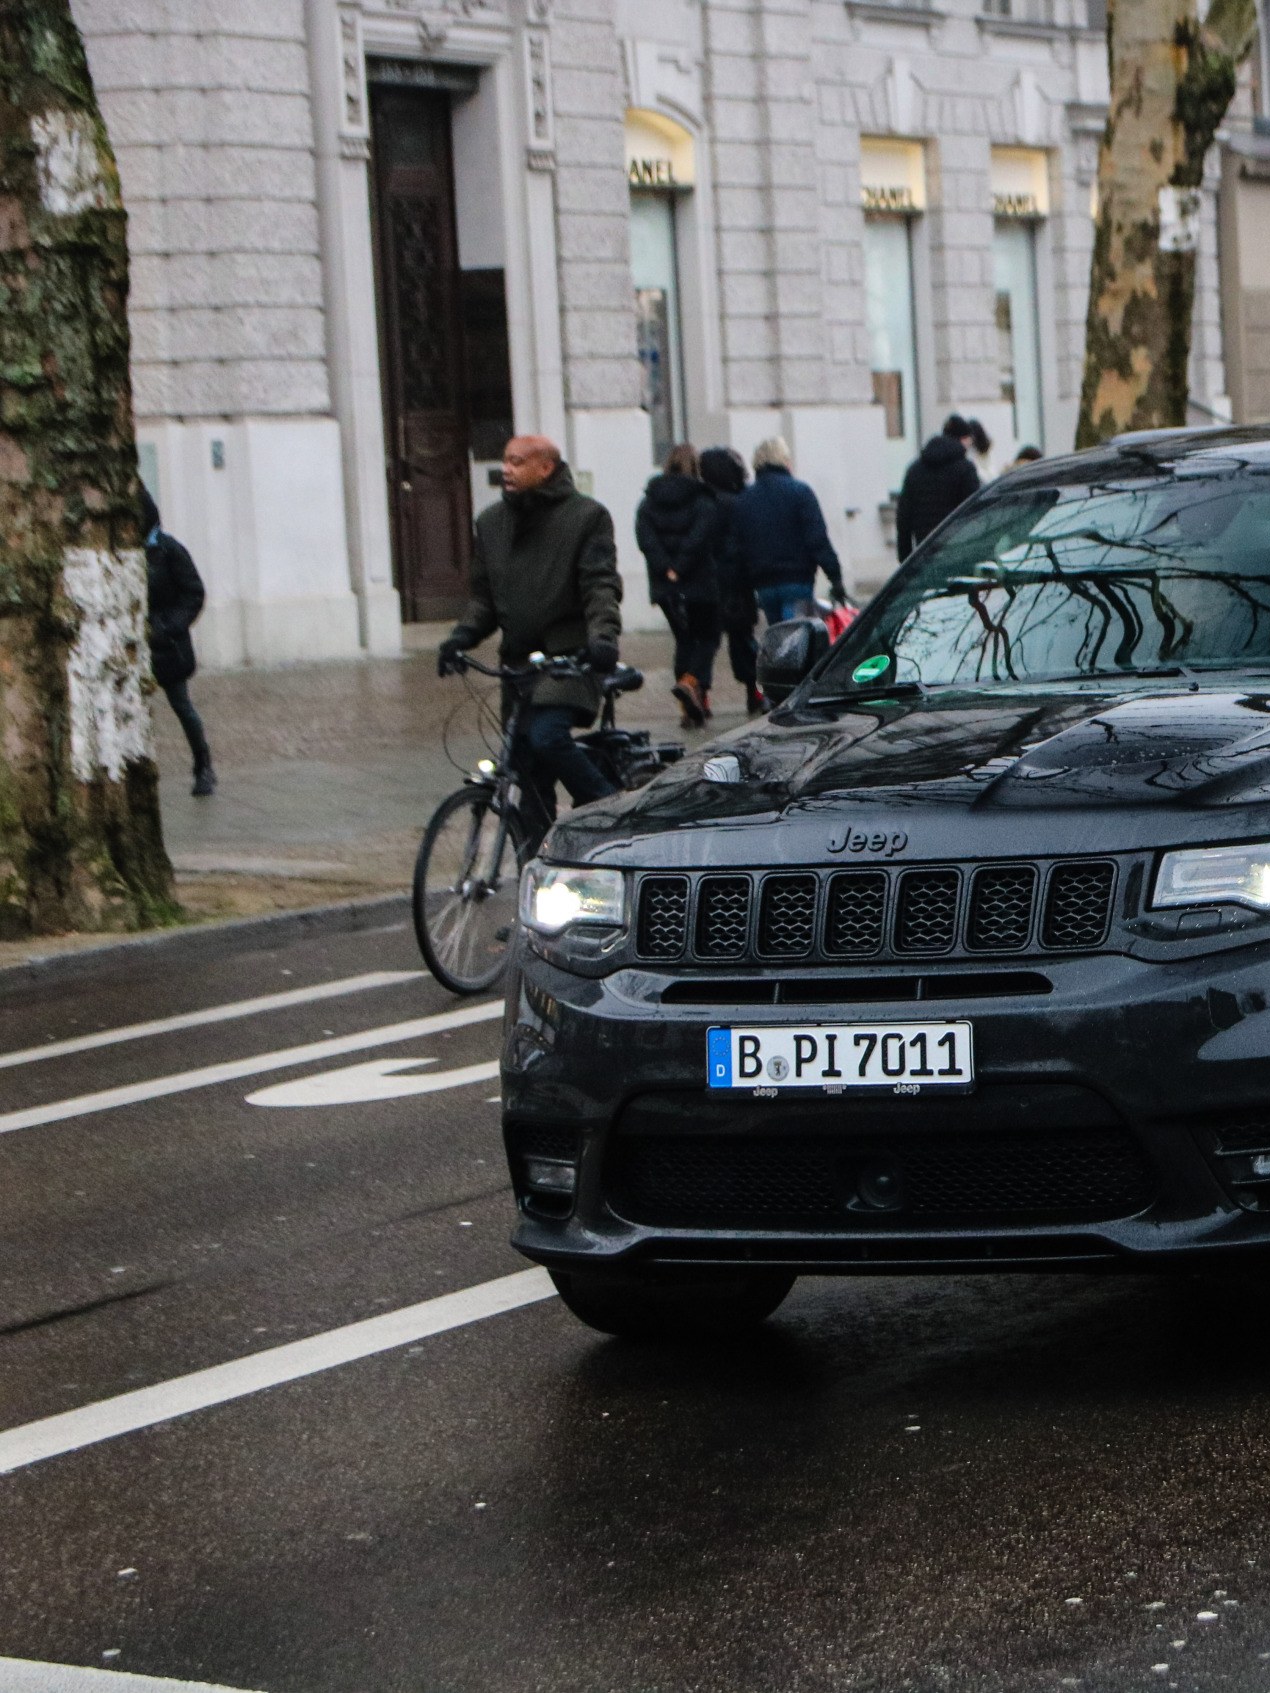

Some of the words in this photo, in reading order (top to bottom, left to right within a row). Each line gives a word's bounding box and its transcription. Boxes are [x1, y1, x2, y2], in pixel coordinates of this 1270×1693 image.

[825, 825, 909, 858] Jeep
[738, 1034, 763, 1078] B
[716, 1064, 725, 1077] D
[753, 1085, 778, 1098] Jeep
[893, 1082, 921, 1095] Jeep
